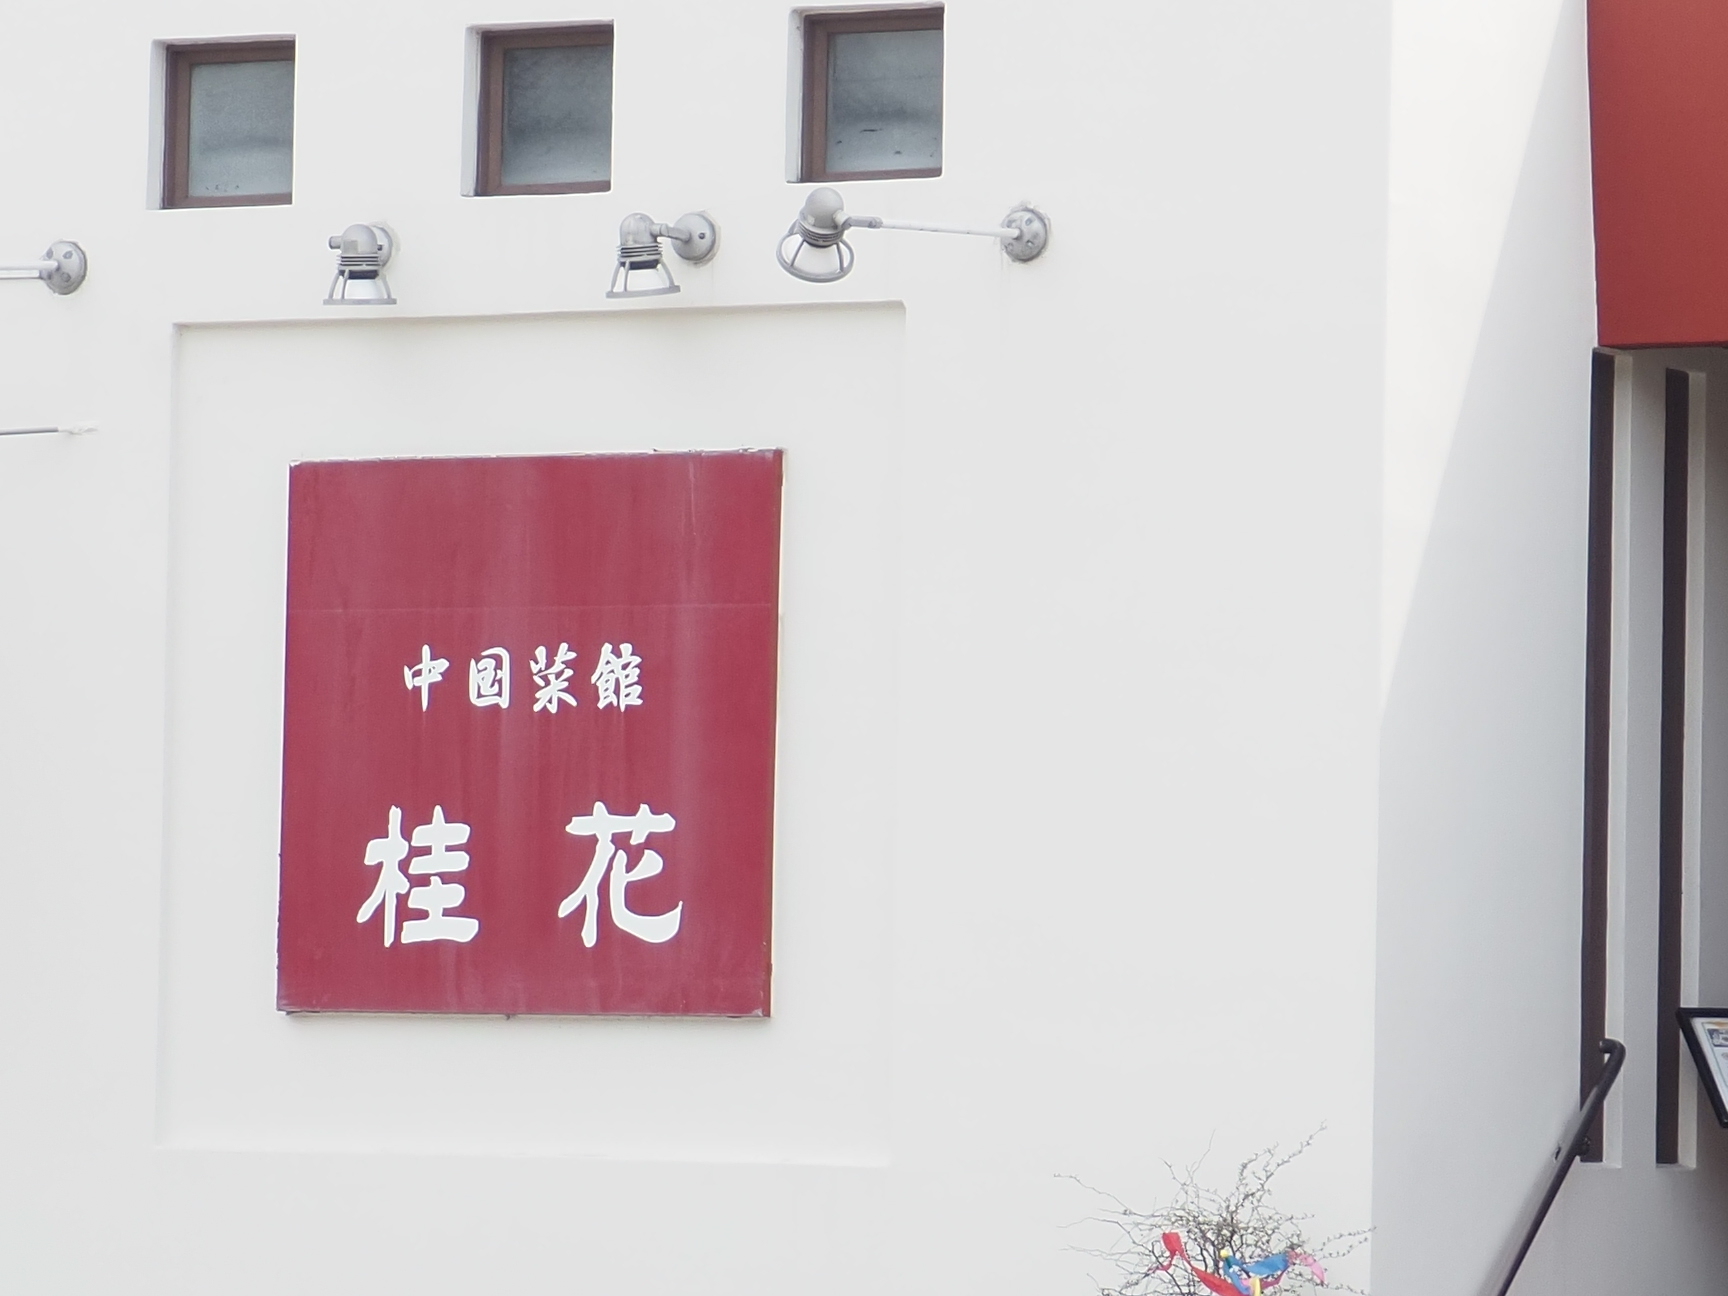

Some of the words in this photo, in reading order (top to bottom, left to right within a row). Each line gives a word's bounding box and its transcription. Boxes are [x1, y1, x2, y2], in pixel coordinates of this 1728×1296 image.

[403, 642, 644, 713] 中国菜館
[357, 801, 683, 947] 桂花
